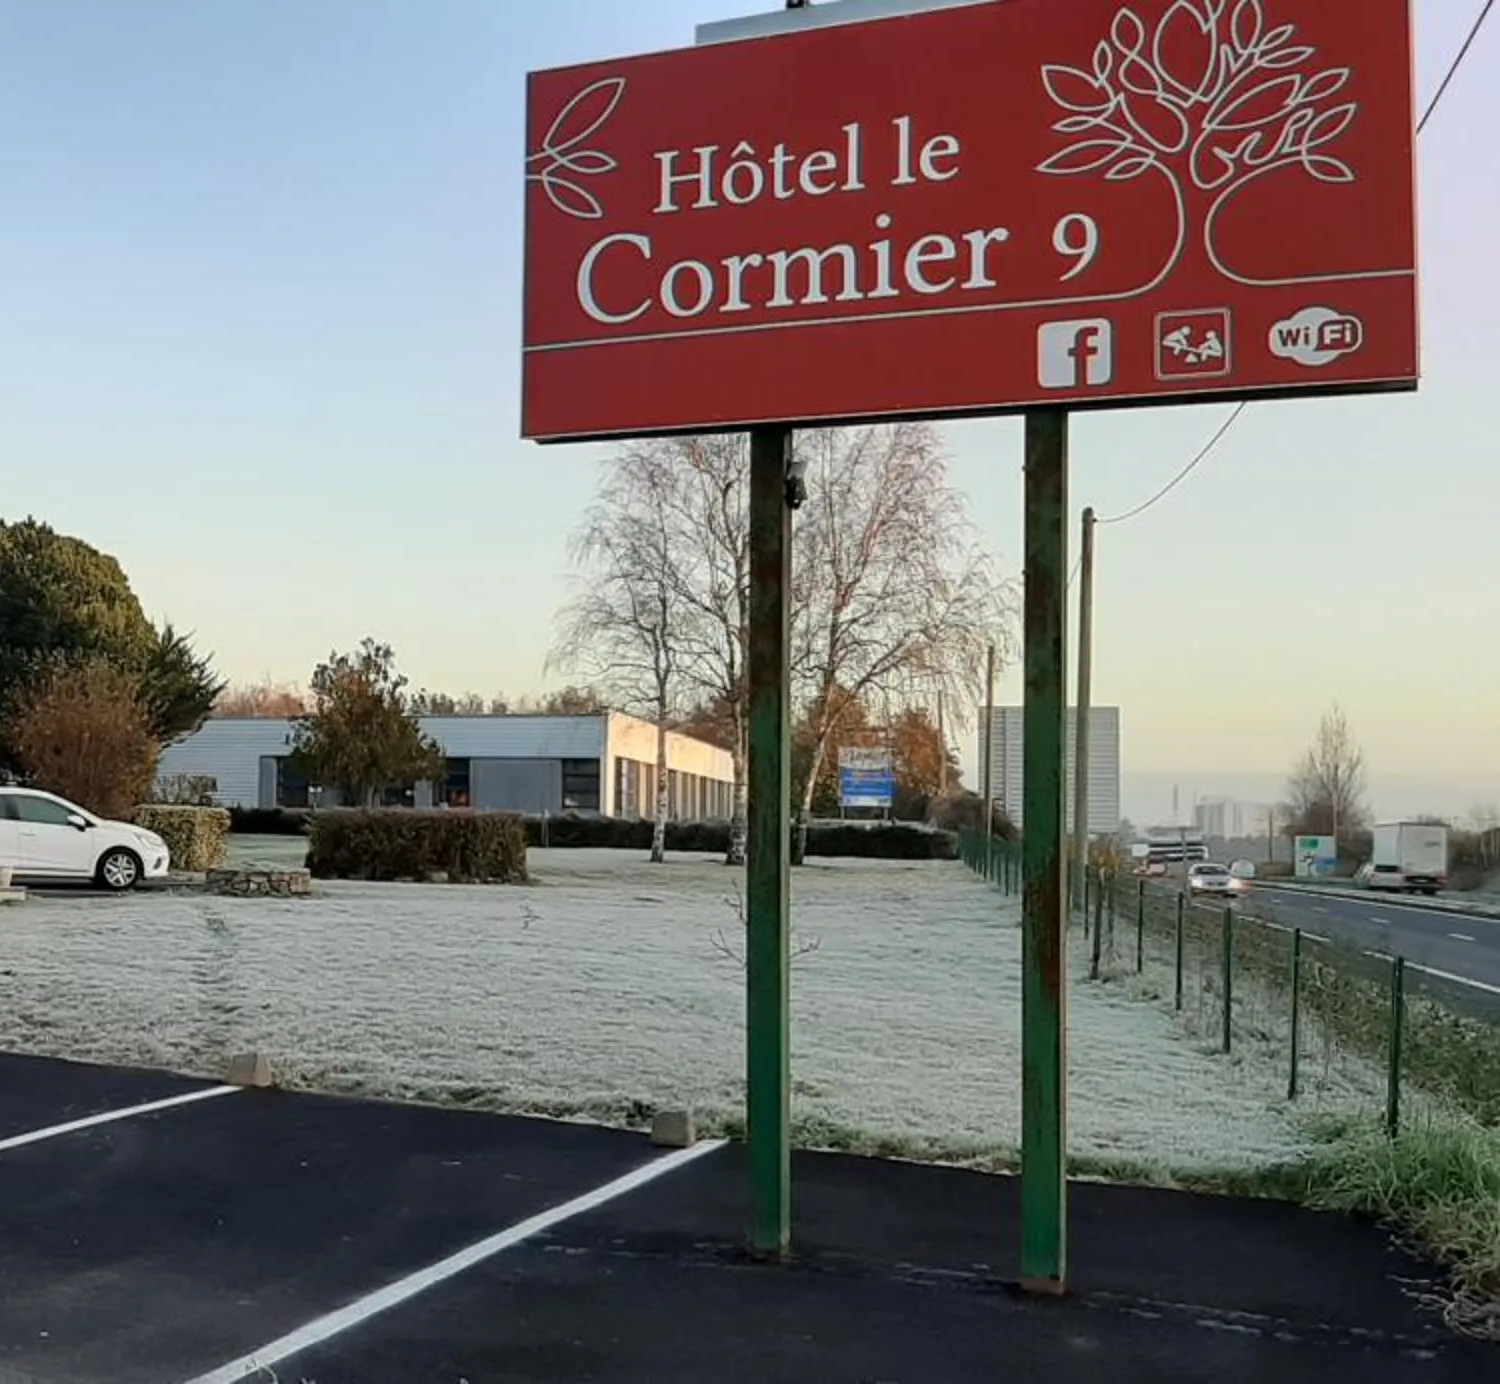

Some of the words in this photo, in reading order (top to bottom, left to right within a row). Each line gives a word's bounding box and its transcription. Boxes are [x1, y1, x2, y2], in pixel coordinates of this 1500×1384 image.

[653, 122, 865, 213] Hôtel
[891, 115, 960, 185] le
[577, 213, 1010, 324] Cormier
[1052, 212, 1098, 282] 9
